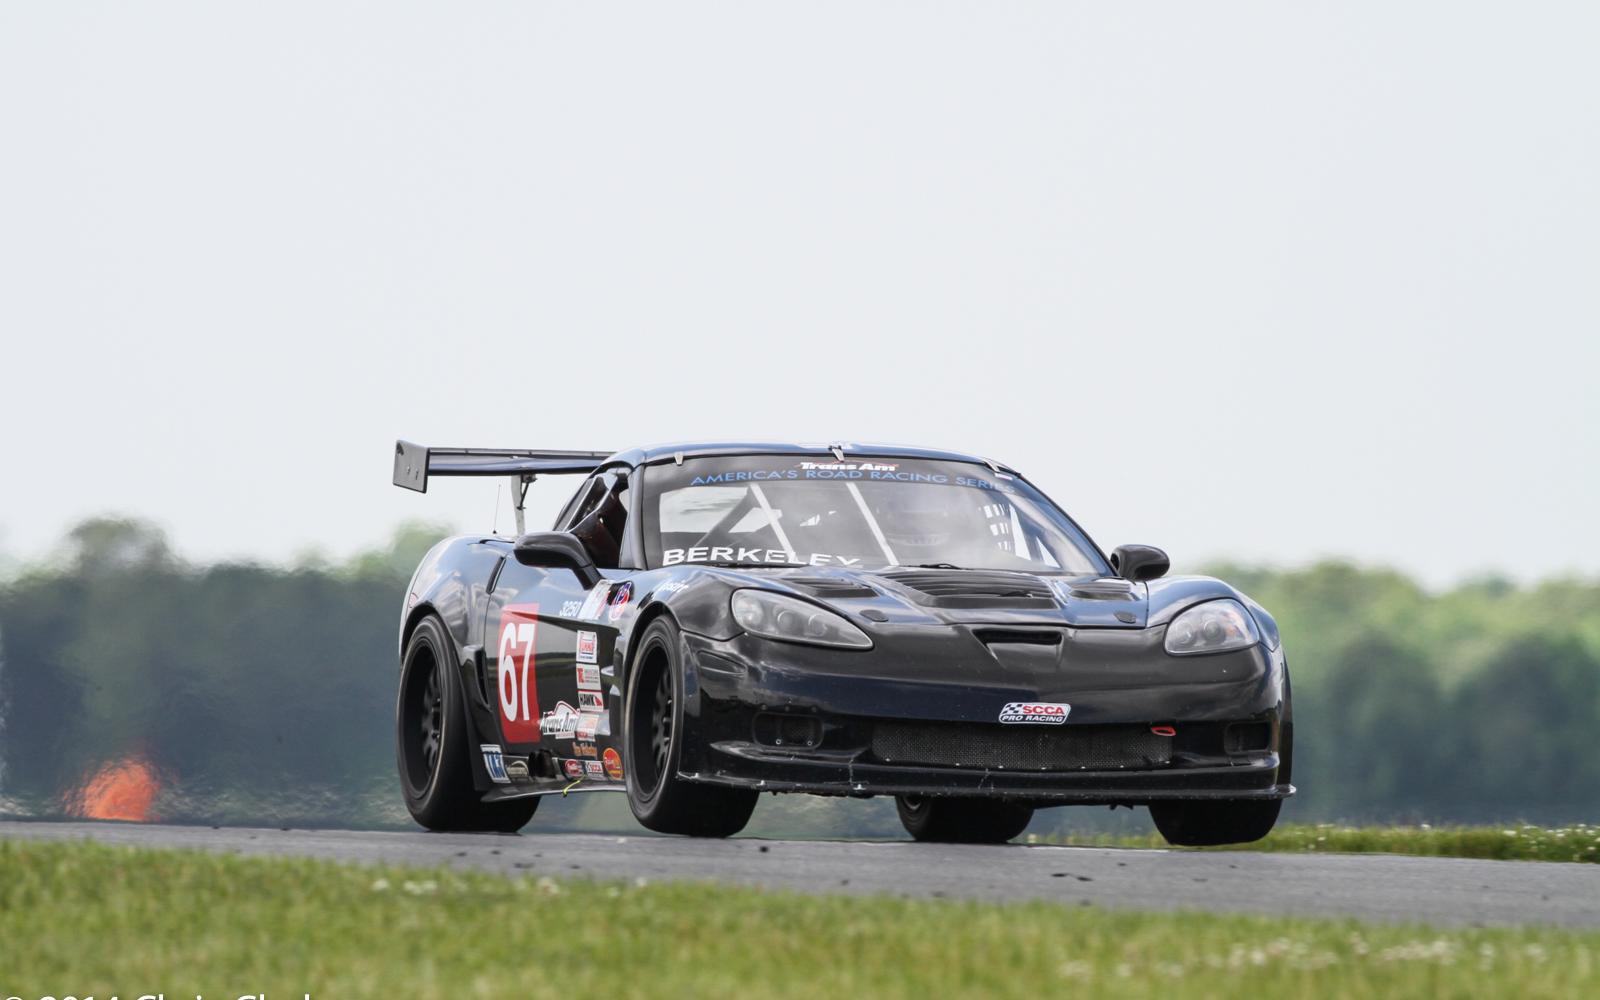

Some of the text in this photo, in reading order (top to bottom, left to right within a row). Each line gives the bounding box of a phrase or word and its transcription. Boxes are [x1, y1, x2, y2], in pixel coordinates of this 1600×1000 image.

[801, 462, 896, 471] Trans Am
[691, 470, 1015, 494] AMERICA'S ROAD RACING SERIES
[662, 546, 863, 567] BERKELEY
[499, 622, 536, 722] 67
[1022, 705, 1065, 715] SCCA
